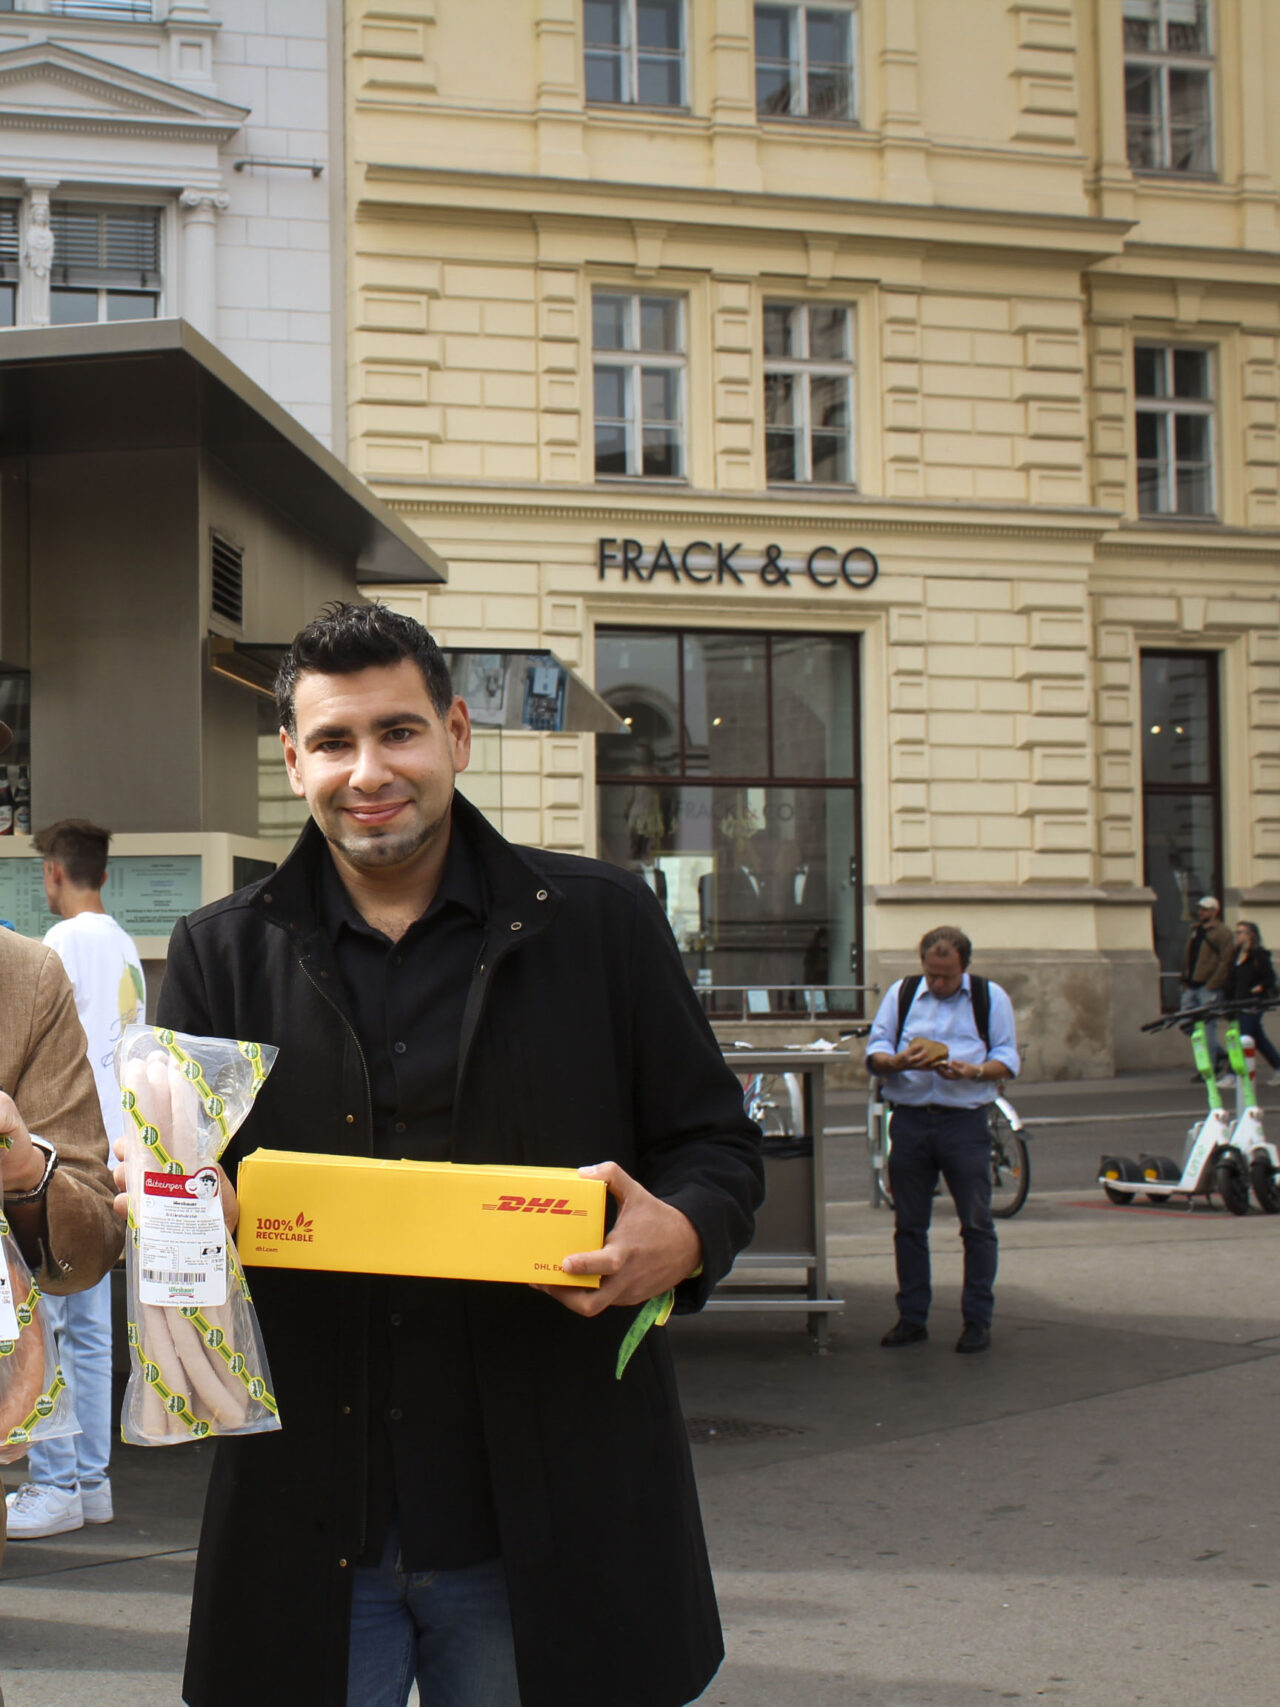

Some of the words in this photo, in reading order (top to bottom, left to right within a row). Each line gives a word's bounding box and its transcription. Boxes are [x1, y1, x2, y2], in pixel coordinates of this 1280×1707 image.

[598, 537, 745, 586] FRACK
[760, 543, 792, 587] &
[806, 545, 879, 589] CO
[145, 1178, 184, 1192] Bitzinger
[496, 1195, 573, 1215] DHL
[256, 1217, 294, 1232] 100%
[256, 1231, 314, 1242] RECYCLABLE
[534, 1263, 552, 1271] DHL
